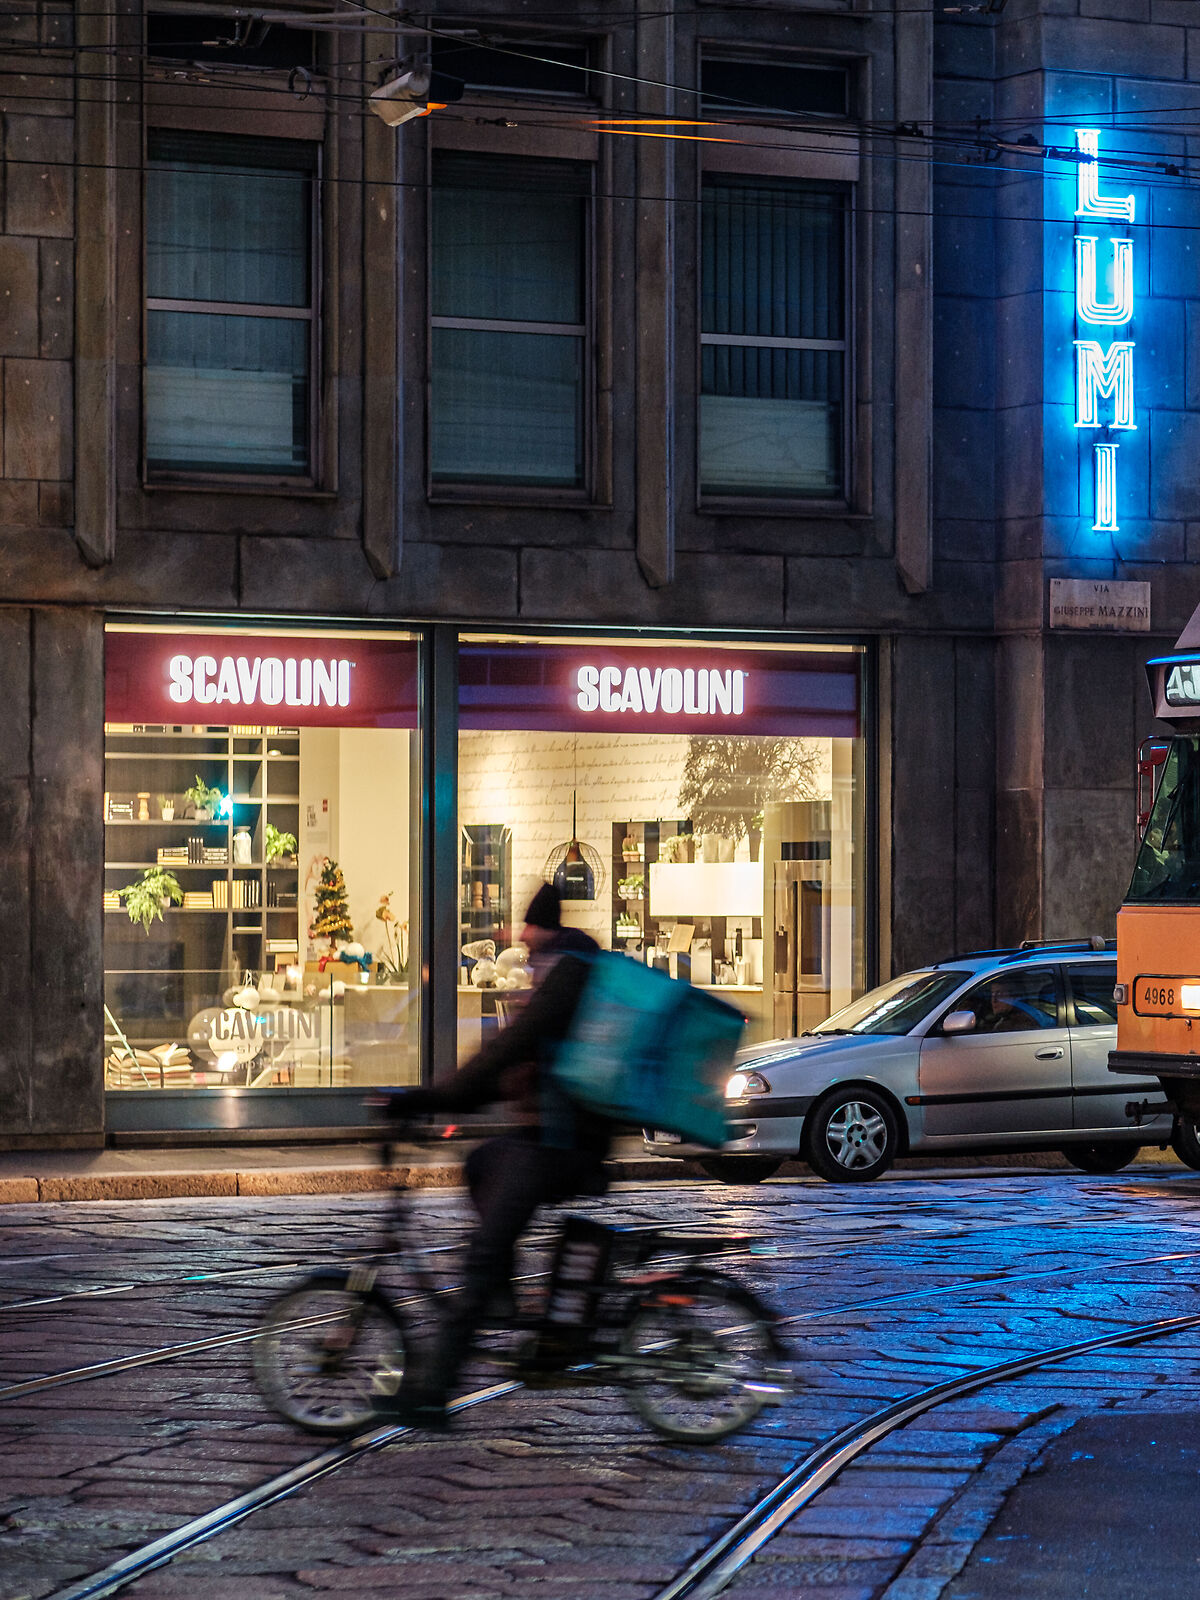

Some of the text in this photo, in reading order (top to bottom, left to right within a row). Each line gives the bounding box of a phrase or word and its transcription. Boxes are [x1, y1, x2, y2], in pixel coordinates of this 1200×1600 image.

[1073, 128, 1137, 531] LUMI
[1093, 584, 1110, 593] VIA
[1054, 605, 1149, 619] GIUSEPPE MAZZINI
[168, 655, 351, 707] SCAVOLINI
[577, 666, 745, 715] SCAVOLINI
[1144, 987, 1175, 1006] 4968
